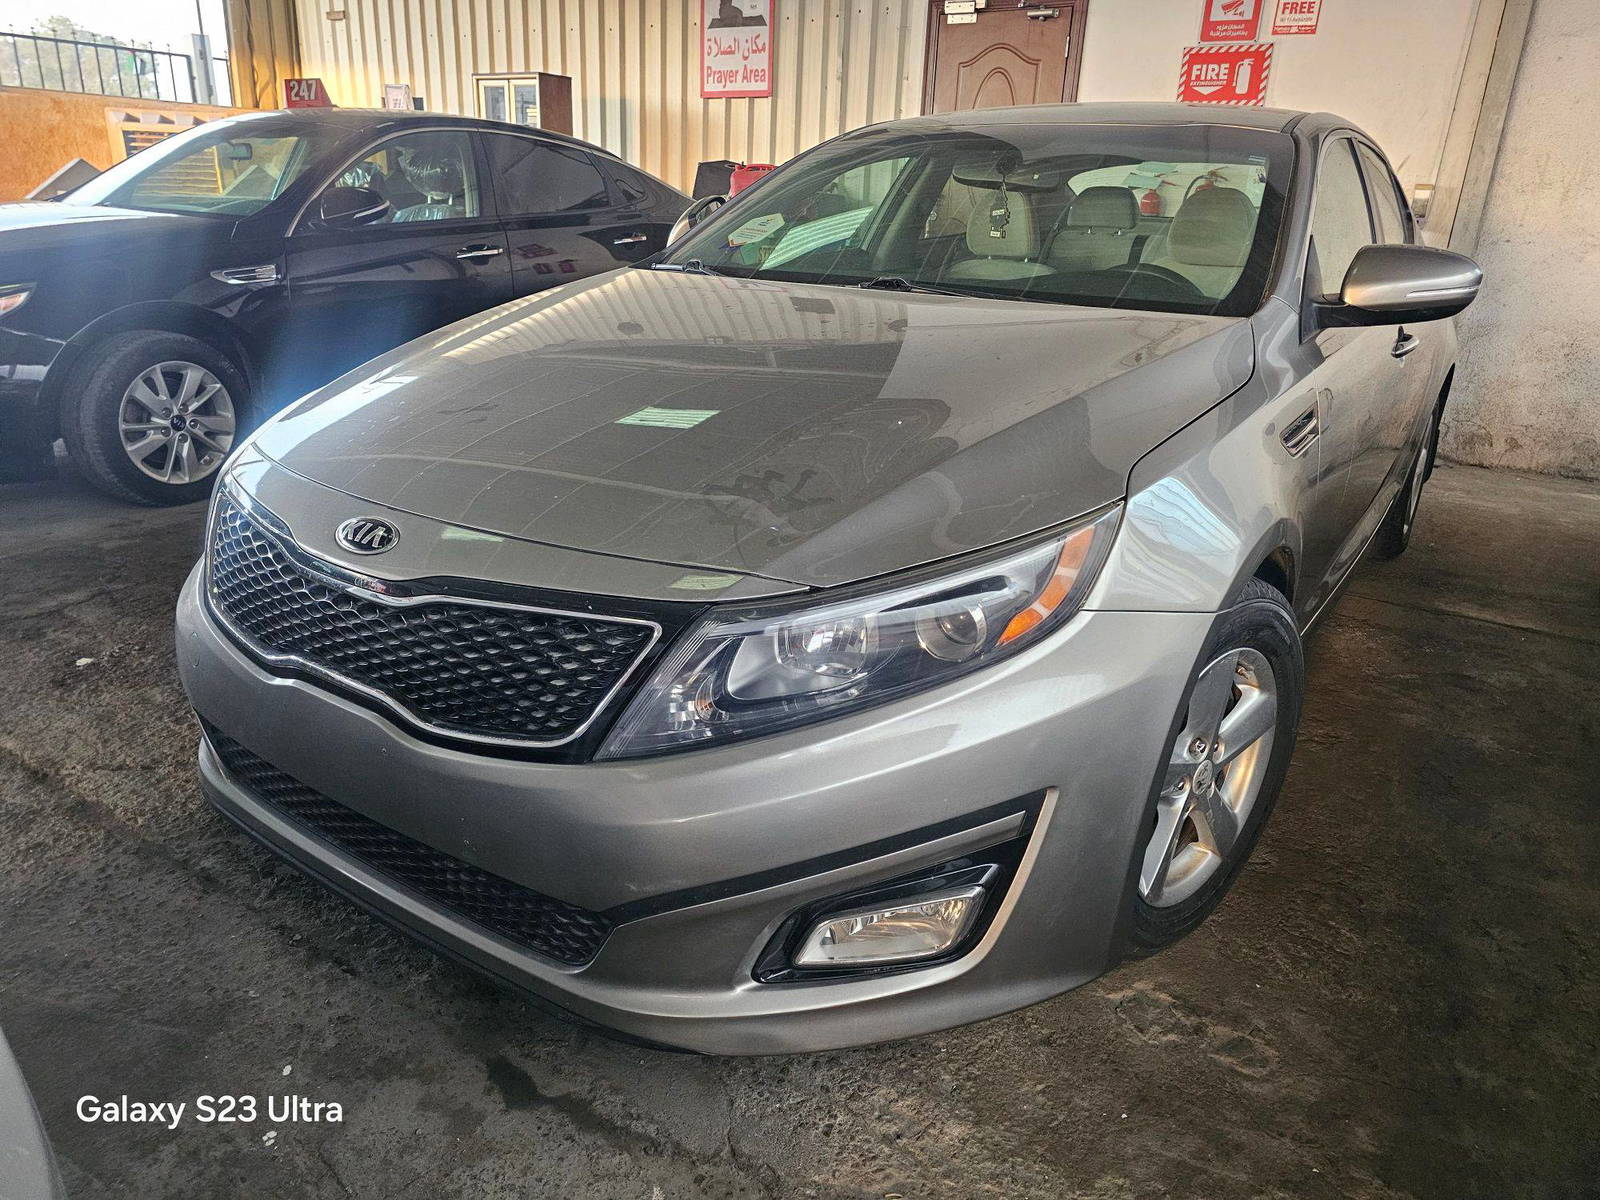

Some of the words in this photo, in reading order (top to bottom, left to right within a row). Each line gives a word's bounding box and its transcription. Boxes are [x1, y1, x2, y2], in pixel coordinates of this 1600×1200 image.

[1281, 1, 1316, 14] FREE
[707, 36, 740, 58] الصلاة
[742, 33, 766, 60] مكان
[706, 66, 739, 88] Prayer
[742, 65, 766, 84] Area
[1191, 63, 1229, 81] FIRE
[289, 80, 317, 101] 247
[341, 520, 386, 548] KIA
